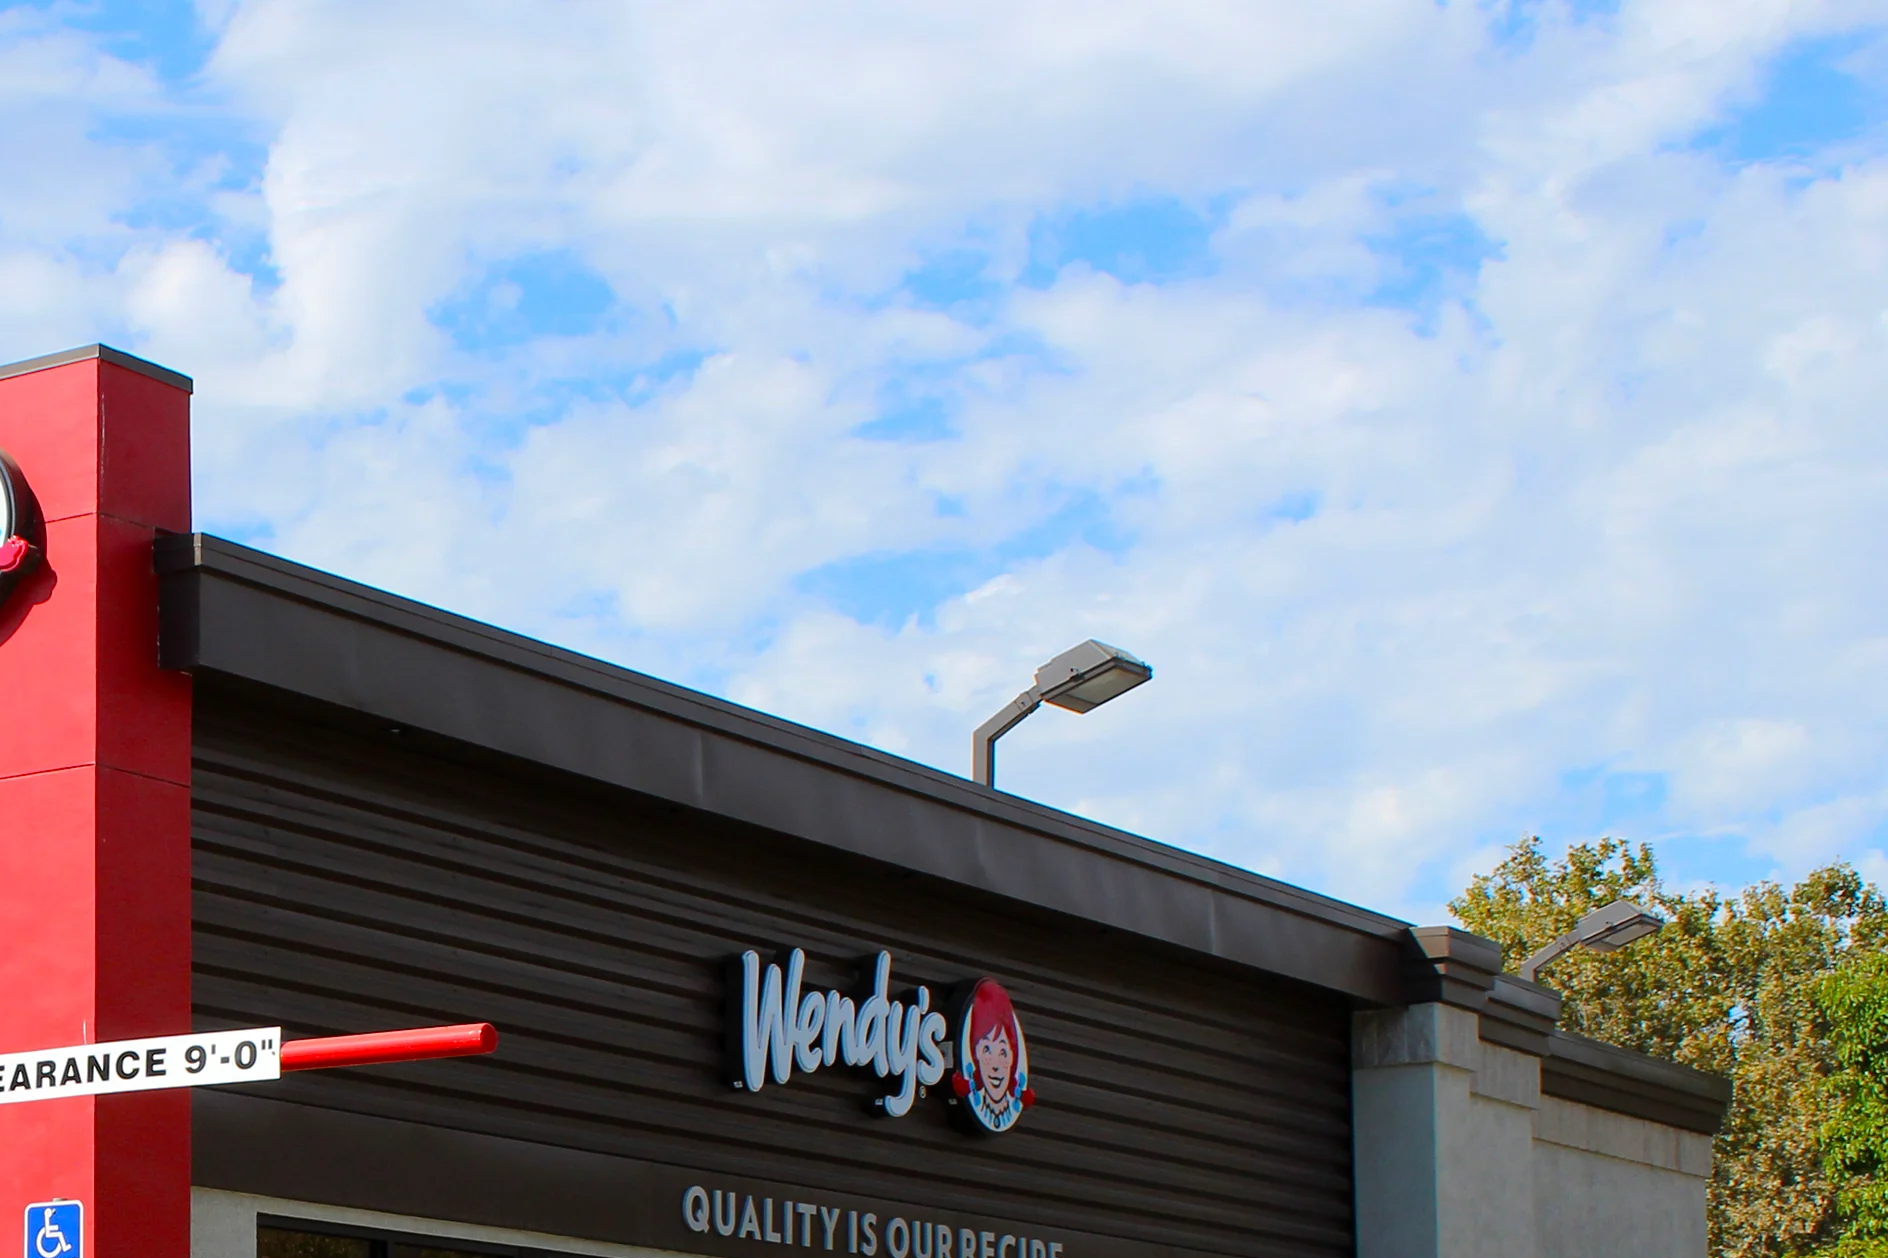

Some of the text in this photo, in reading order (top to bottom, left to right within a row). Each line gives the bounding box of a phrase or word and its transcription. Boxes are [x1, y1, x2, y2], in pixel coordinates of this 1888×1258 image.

[184, 1038, 274, 1074] 9'-0"
[742, 947, 947, 1118] Wendy's
[682, 1185, 840, 1251] QUALITY
[848, 1210, 878, 1257] IS
